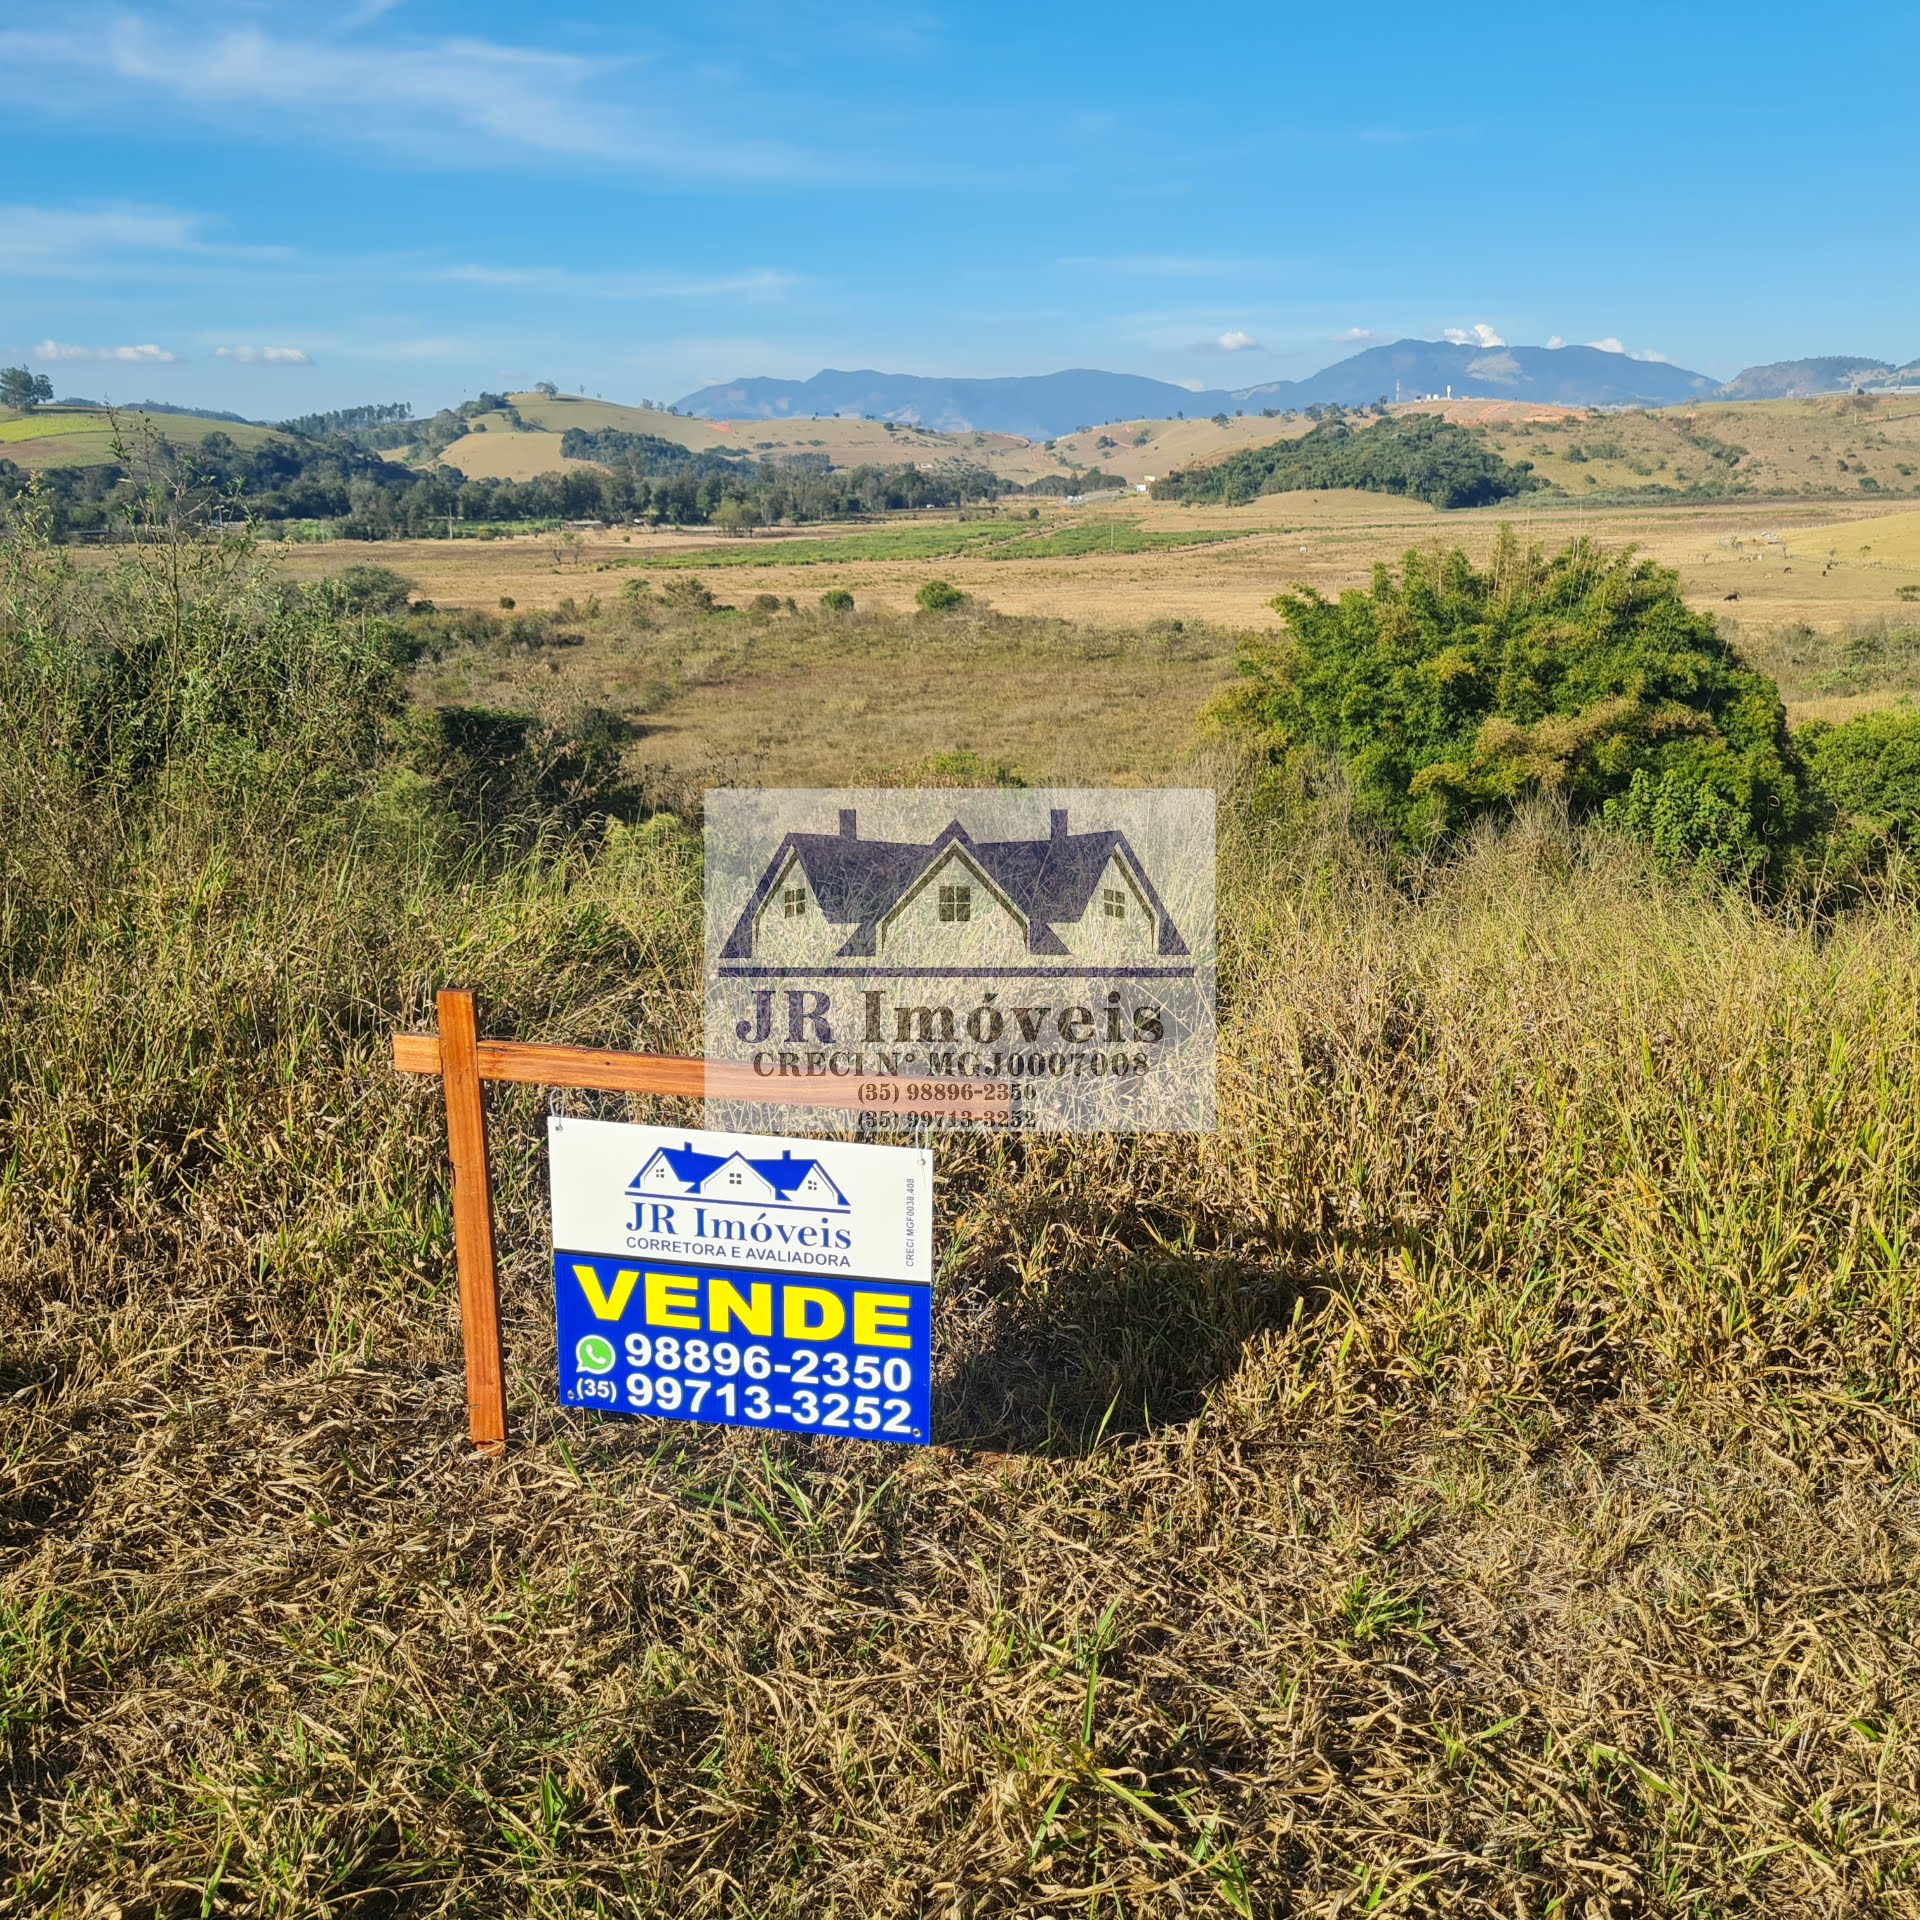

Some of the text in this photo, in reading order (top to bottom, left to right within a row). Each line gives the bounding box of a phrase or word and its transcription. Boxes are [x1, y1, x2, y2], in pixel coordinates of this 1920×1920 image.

[626, 1201, 852, 1250] JR Imóveis
[626, 1236, 851, 1268] CORRETORA E AVALIADORA
[905, 1177, 915, 1268] CRECI MGF0038.408
[572, 1265, 912, 1350] VENDE
[624, 1332, 912, 1393] 98896-2350
[576, 1372, 913, 1434] (35) 99713-3252
